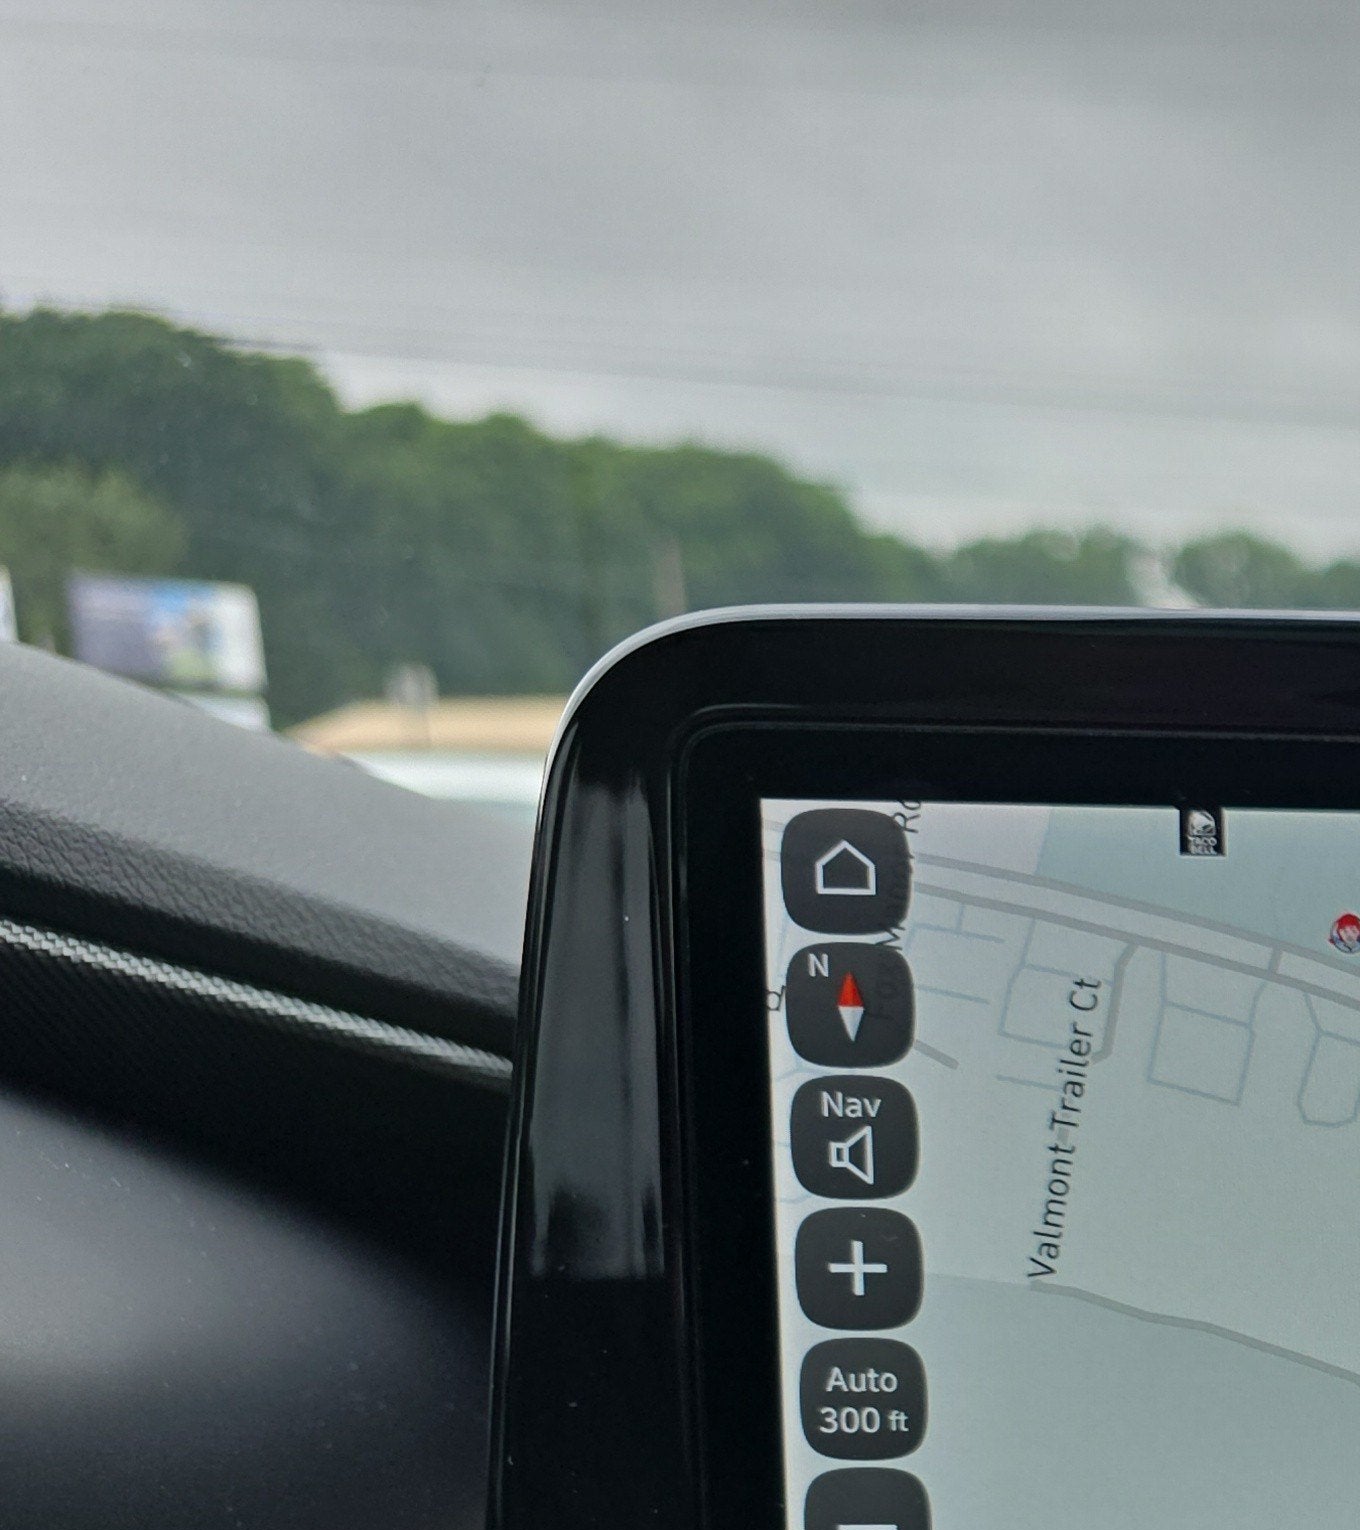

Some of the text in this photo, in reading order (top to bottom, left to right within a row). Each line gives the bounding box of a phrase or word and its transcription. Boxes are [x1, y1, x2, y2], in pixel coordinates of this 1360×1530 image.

[808, 953, 829, 977] N
[821, 1091, 882, 1119] Nav
[1027, 978, 1104, 1279] Valmont Trailer Ct
[826, 1368, 899, 1393] Auto
[819, 1409, 909, 1434] 300 ft
